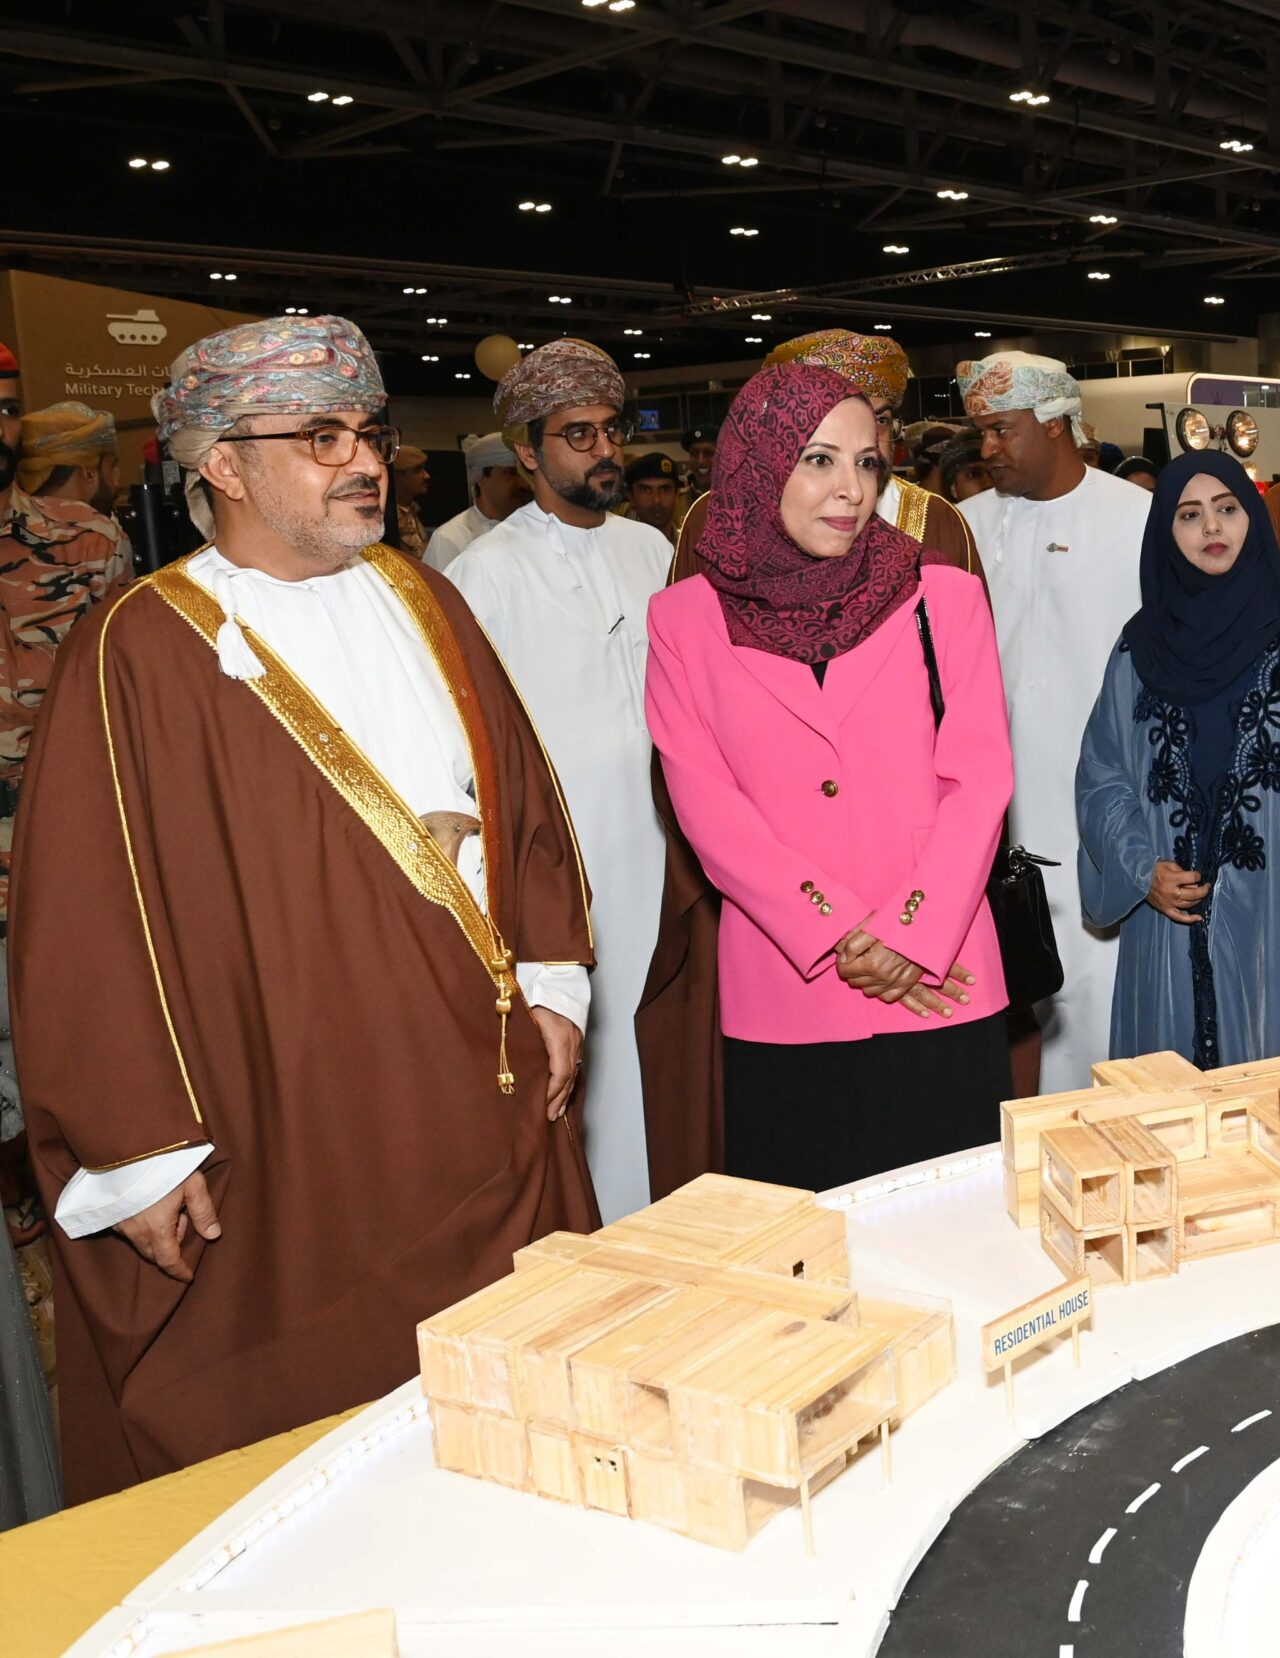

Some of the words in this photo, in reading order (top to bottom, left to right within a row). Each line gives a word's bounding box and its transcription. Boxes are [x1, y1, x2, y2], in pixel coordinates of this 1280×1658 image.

[65, 363, 147, 378] العسكرية
[65, 383, 122, 398] Military
[126, 384, 162, 396] Tech
[994, 1309, 1057, 1356] RESIDENTIAL
[1058, 1290, 1089, 1320] HOUSE
